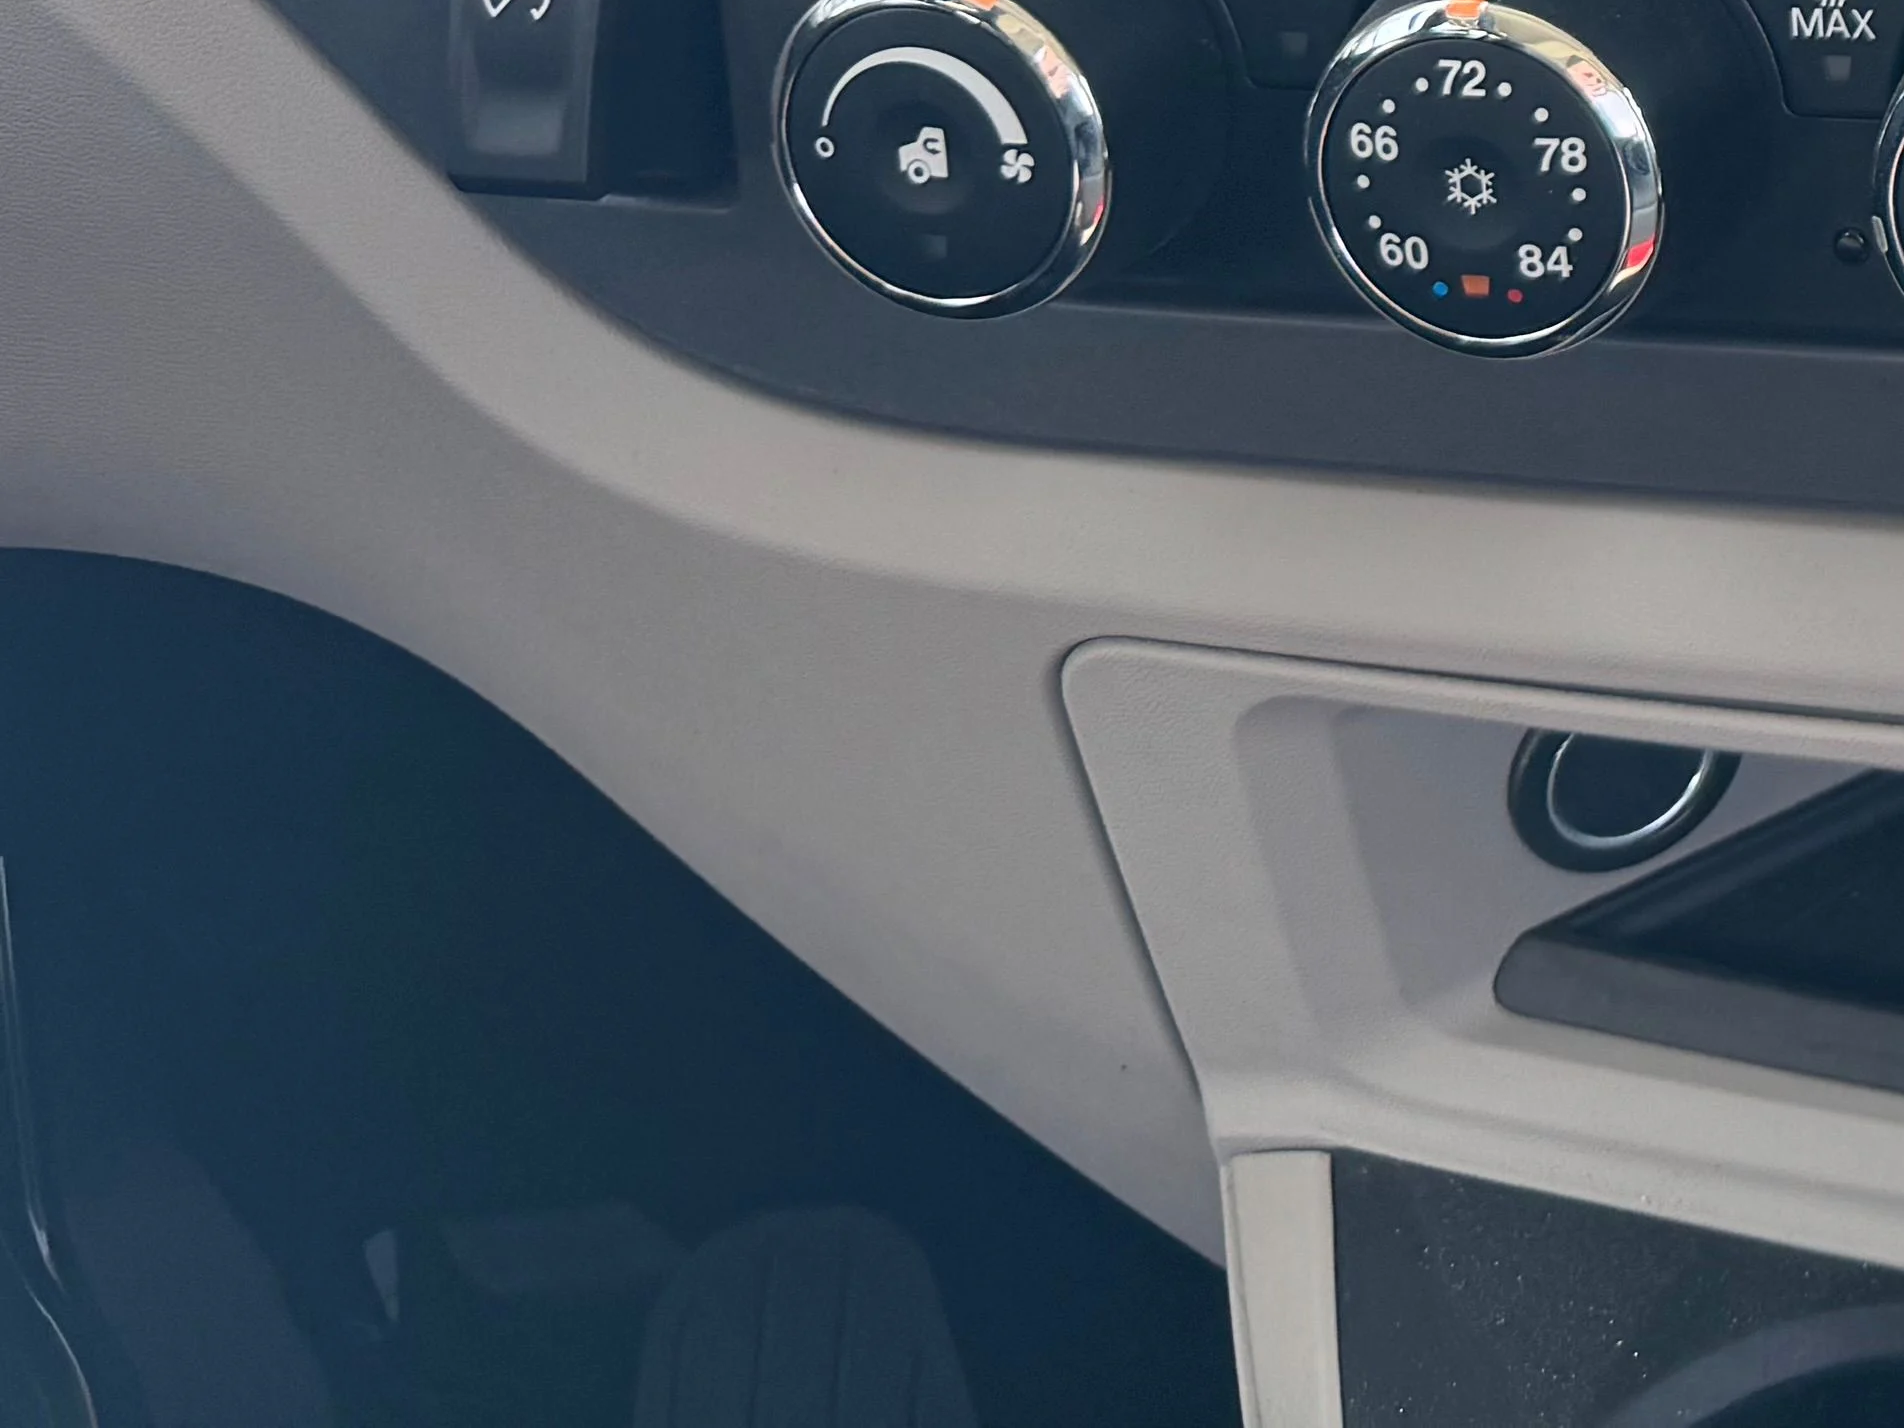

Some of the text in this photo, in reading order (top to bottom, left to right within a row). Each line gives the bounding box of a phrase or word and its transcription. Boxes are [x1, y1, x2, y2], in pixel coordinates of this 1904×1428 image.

[1789, 7, 1876, 42] MAX
[1438, 60, 1486, 97] 72
[1350, 123, 1399, 161] 66
[1534, 137, 1588, 173] 78
[1379, 233, 1429, 270] 60
[1517, 245, 1574, 279] 84
